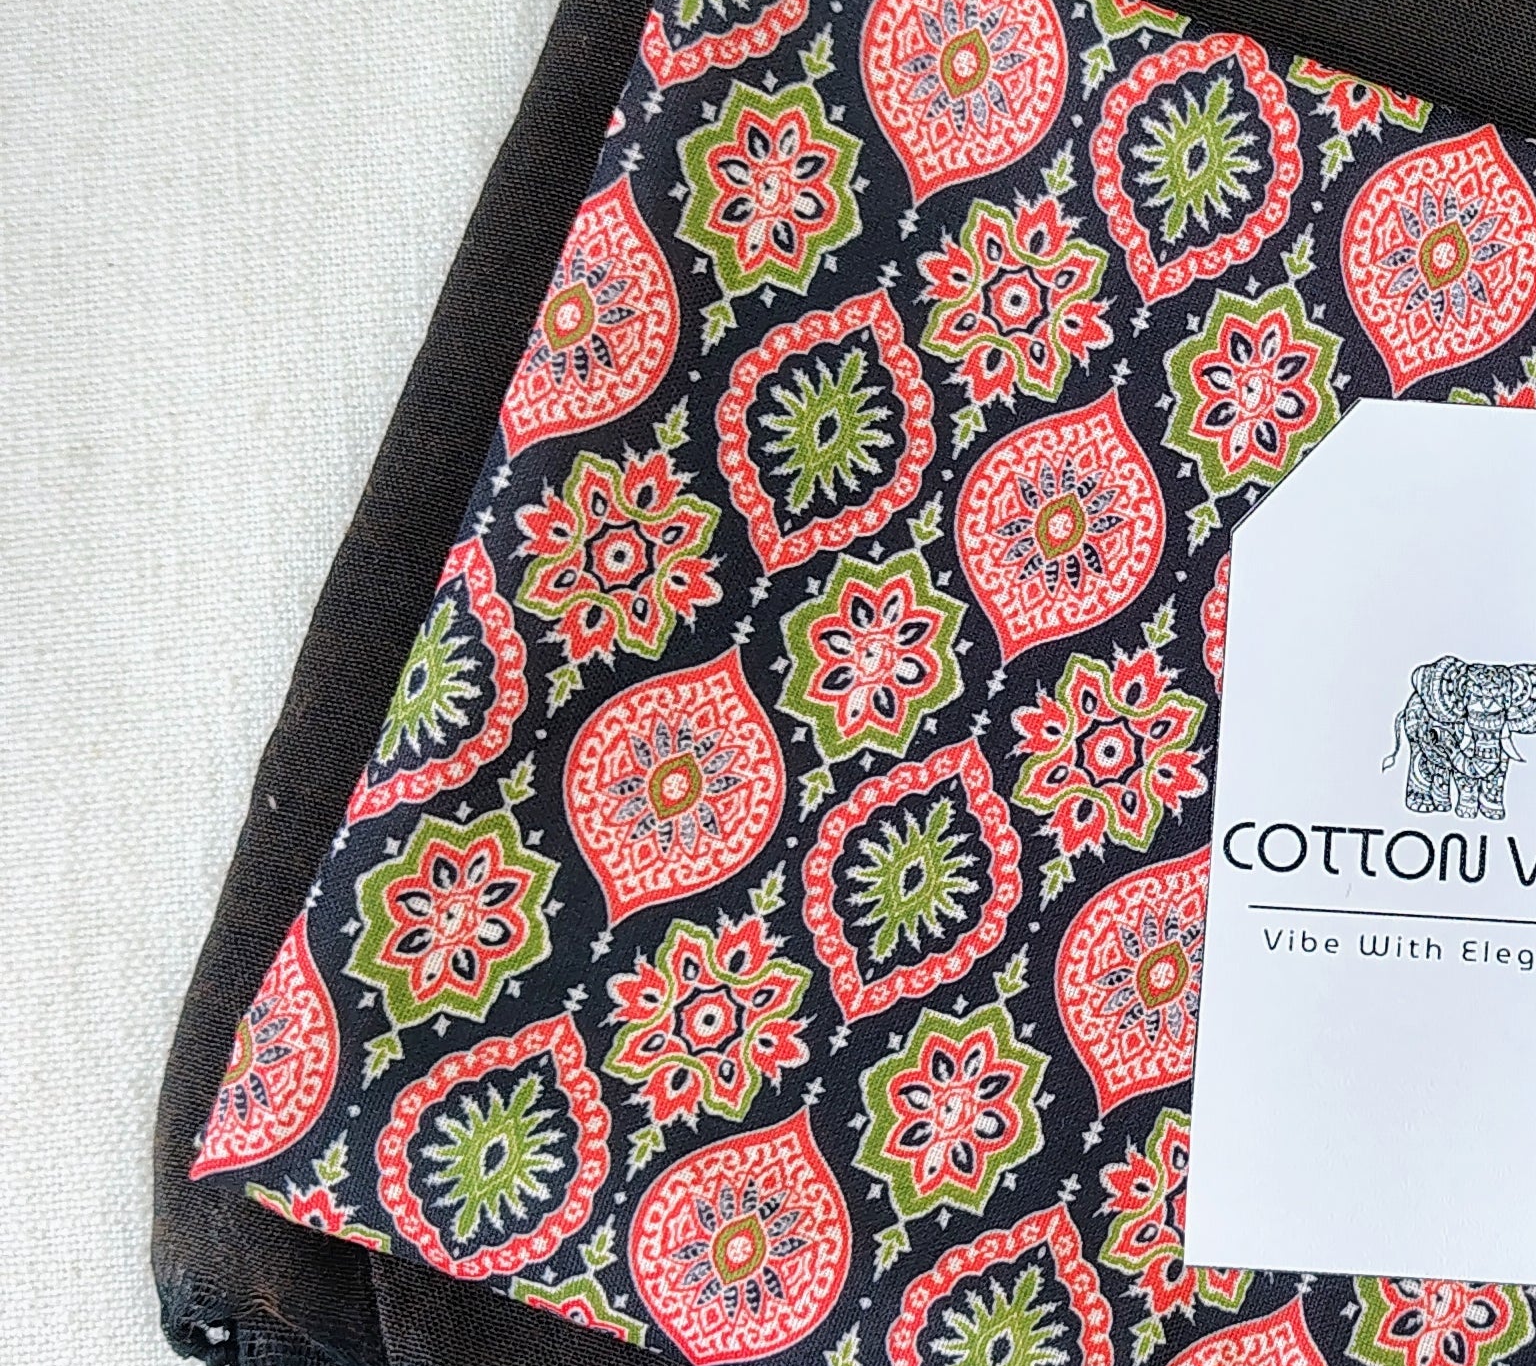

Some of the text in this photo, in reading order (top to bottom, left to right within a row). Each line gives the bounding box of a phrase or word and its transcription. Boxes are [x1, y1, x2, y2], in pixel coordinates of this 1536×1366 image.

[1222, 821, 1488, 884] COTTON
[1263, 928, 1340, 954] Vibe
[1359, 934, 1443, 961] With
